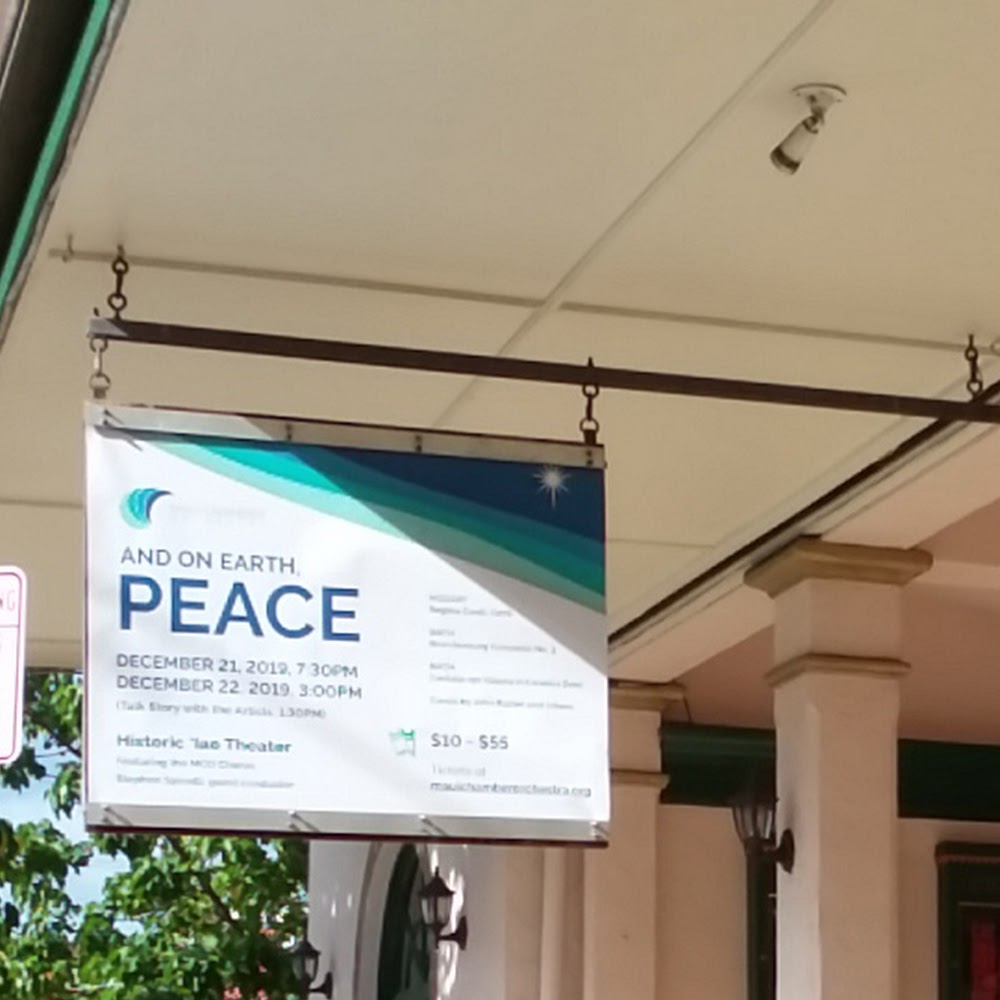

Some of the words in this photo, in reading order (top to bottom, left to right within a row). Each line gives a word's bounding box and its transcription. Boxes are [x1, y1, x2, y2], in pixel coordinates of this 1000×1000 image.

[120, 546, 171, 567] AND
[178, 550, 212, 569] ON
[120, 574, 360, 642] PEACE
[116, 653, 214, 672] DECEMBER
[116, 675, 214, 693] DECEMBER
[299, 683, 363, 699] 3:00PM
[116, 734, 184, 749] Historic
[224, 738, 292, 753] Theater
[430, 733, 463, 747] $10
[479, 735, 509, 750] $55
